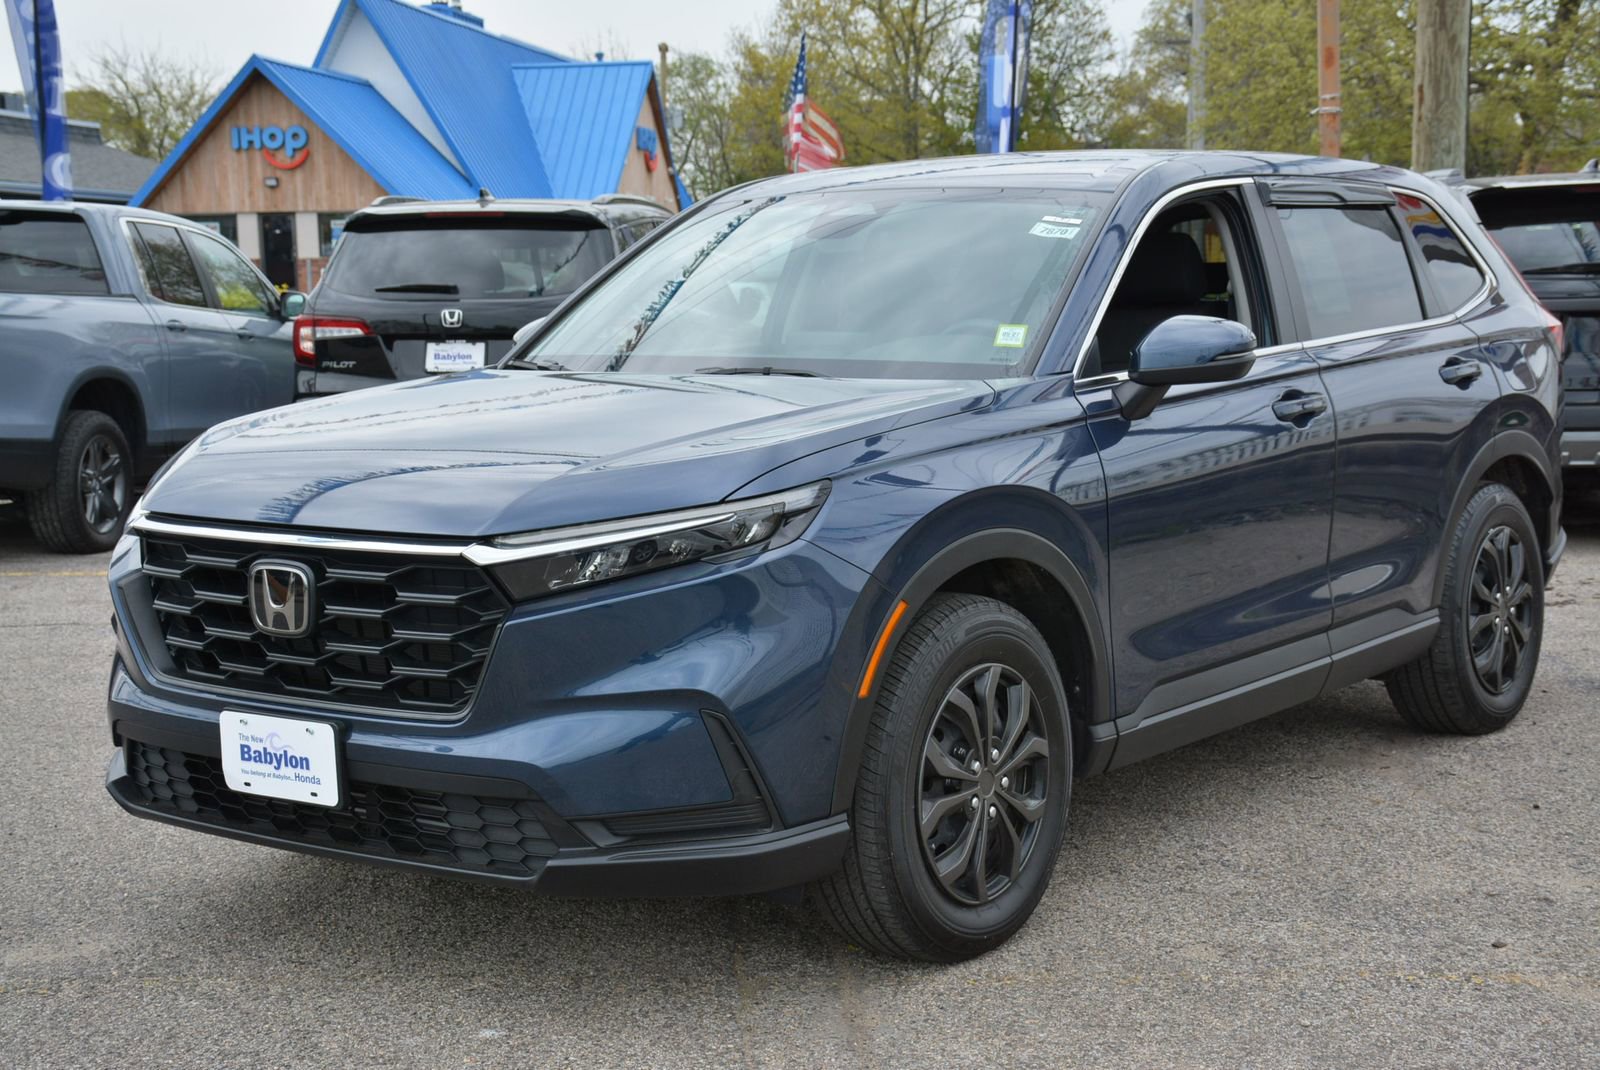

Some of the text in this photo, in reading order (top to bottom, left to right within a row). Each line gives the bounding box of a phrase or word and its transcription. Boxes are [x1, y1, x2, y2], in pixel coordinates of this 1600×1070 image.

[434, 352, 472, 362] Babylon
[322, 360, 357, 369] PILOT
[238, 732, 264, 744] The New
[239, 743, 310, 771] Babylon
[294, 772, 321, 785] Honda
